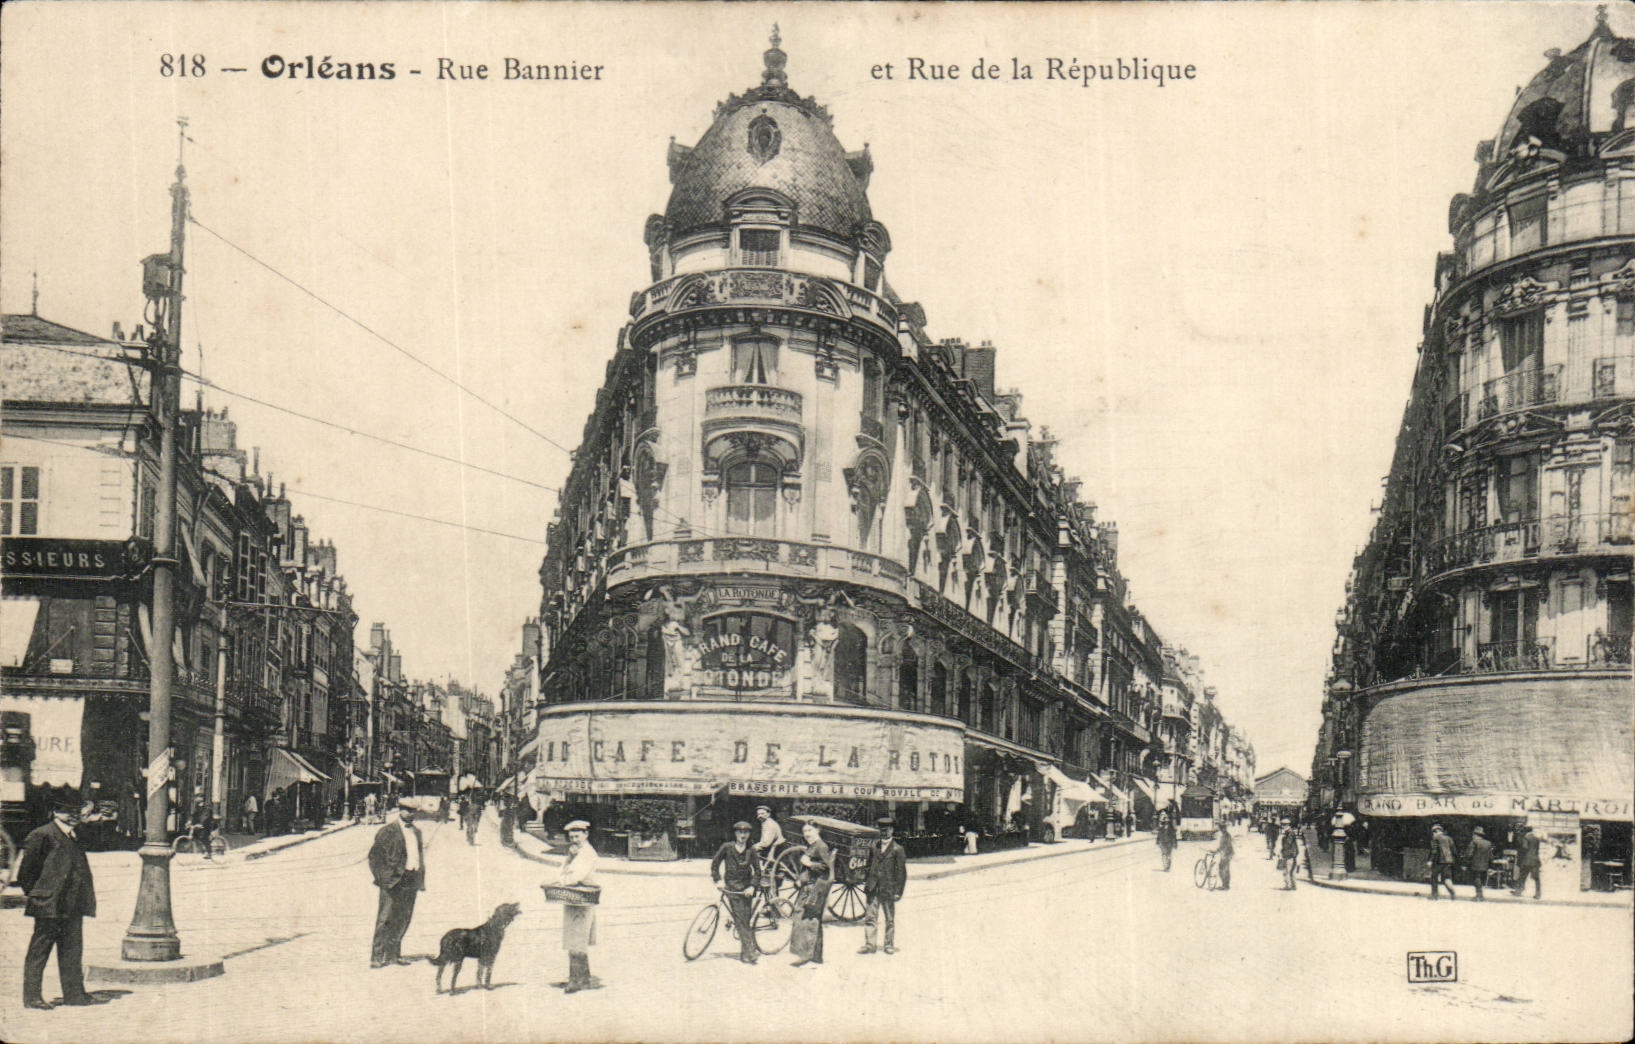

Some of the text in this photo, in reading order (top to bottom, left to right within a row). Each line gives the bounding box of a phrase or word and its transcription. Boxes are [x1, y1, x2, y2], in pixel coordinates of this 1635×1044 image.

[697, 633, 741, 655] RAND
[733, 740, 781, 766] DE
[818, 745, 859, 768] LA
[729, 782, 800, 794] BRASSERIE
[807, 784, 823, 794] DE
